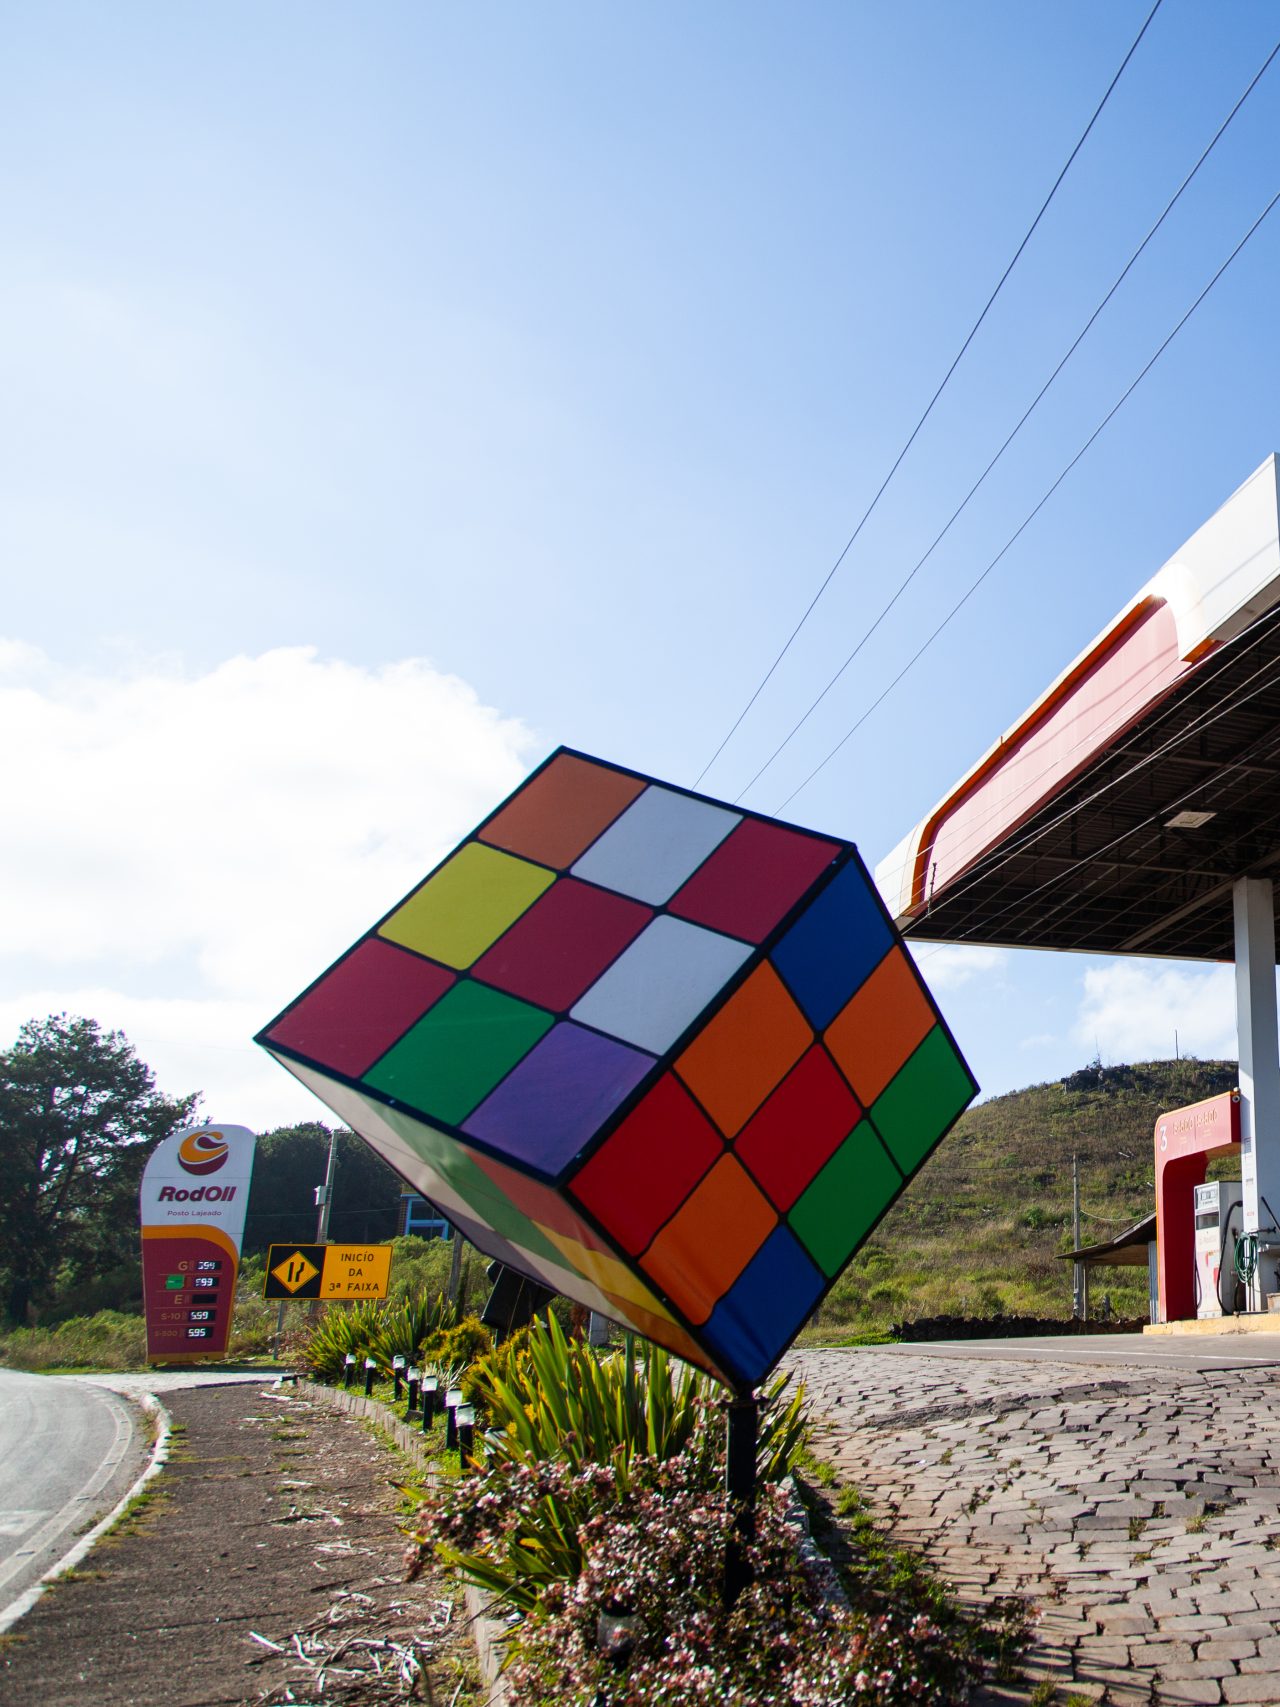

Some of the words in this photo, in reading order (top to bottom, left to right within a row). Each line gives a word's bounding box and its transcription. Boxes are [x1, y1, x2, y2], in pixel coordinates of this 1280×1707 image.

[158, 1186, 237, 1202] RodOil
[177, 1261, 188, 1271] G
[348, 1268, 363, 1277] DA
[329, 1282, 341, 1291] 3ª
[347, 1283, 379, 1291] FAIXA
[174, 1295, 183, 1304] E
